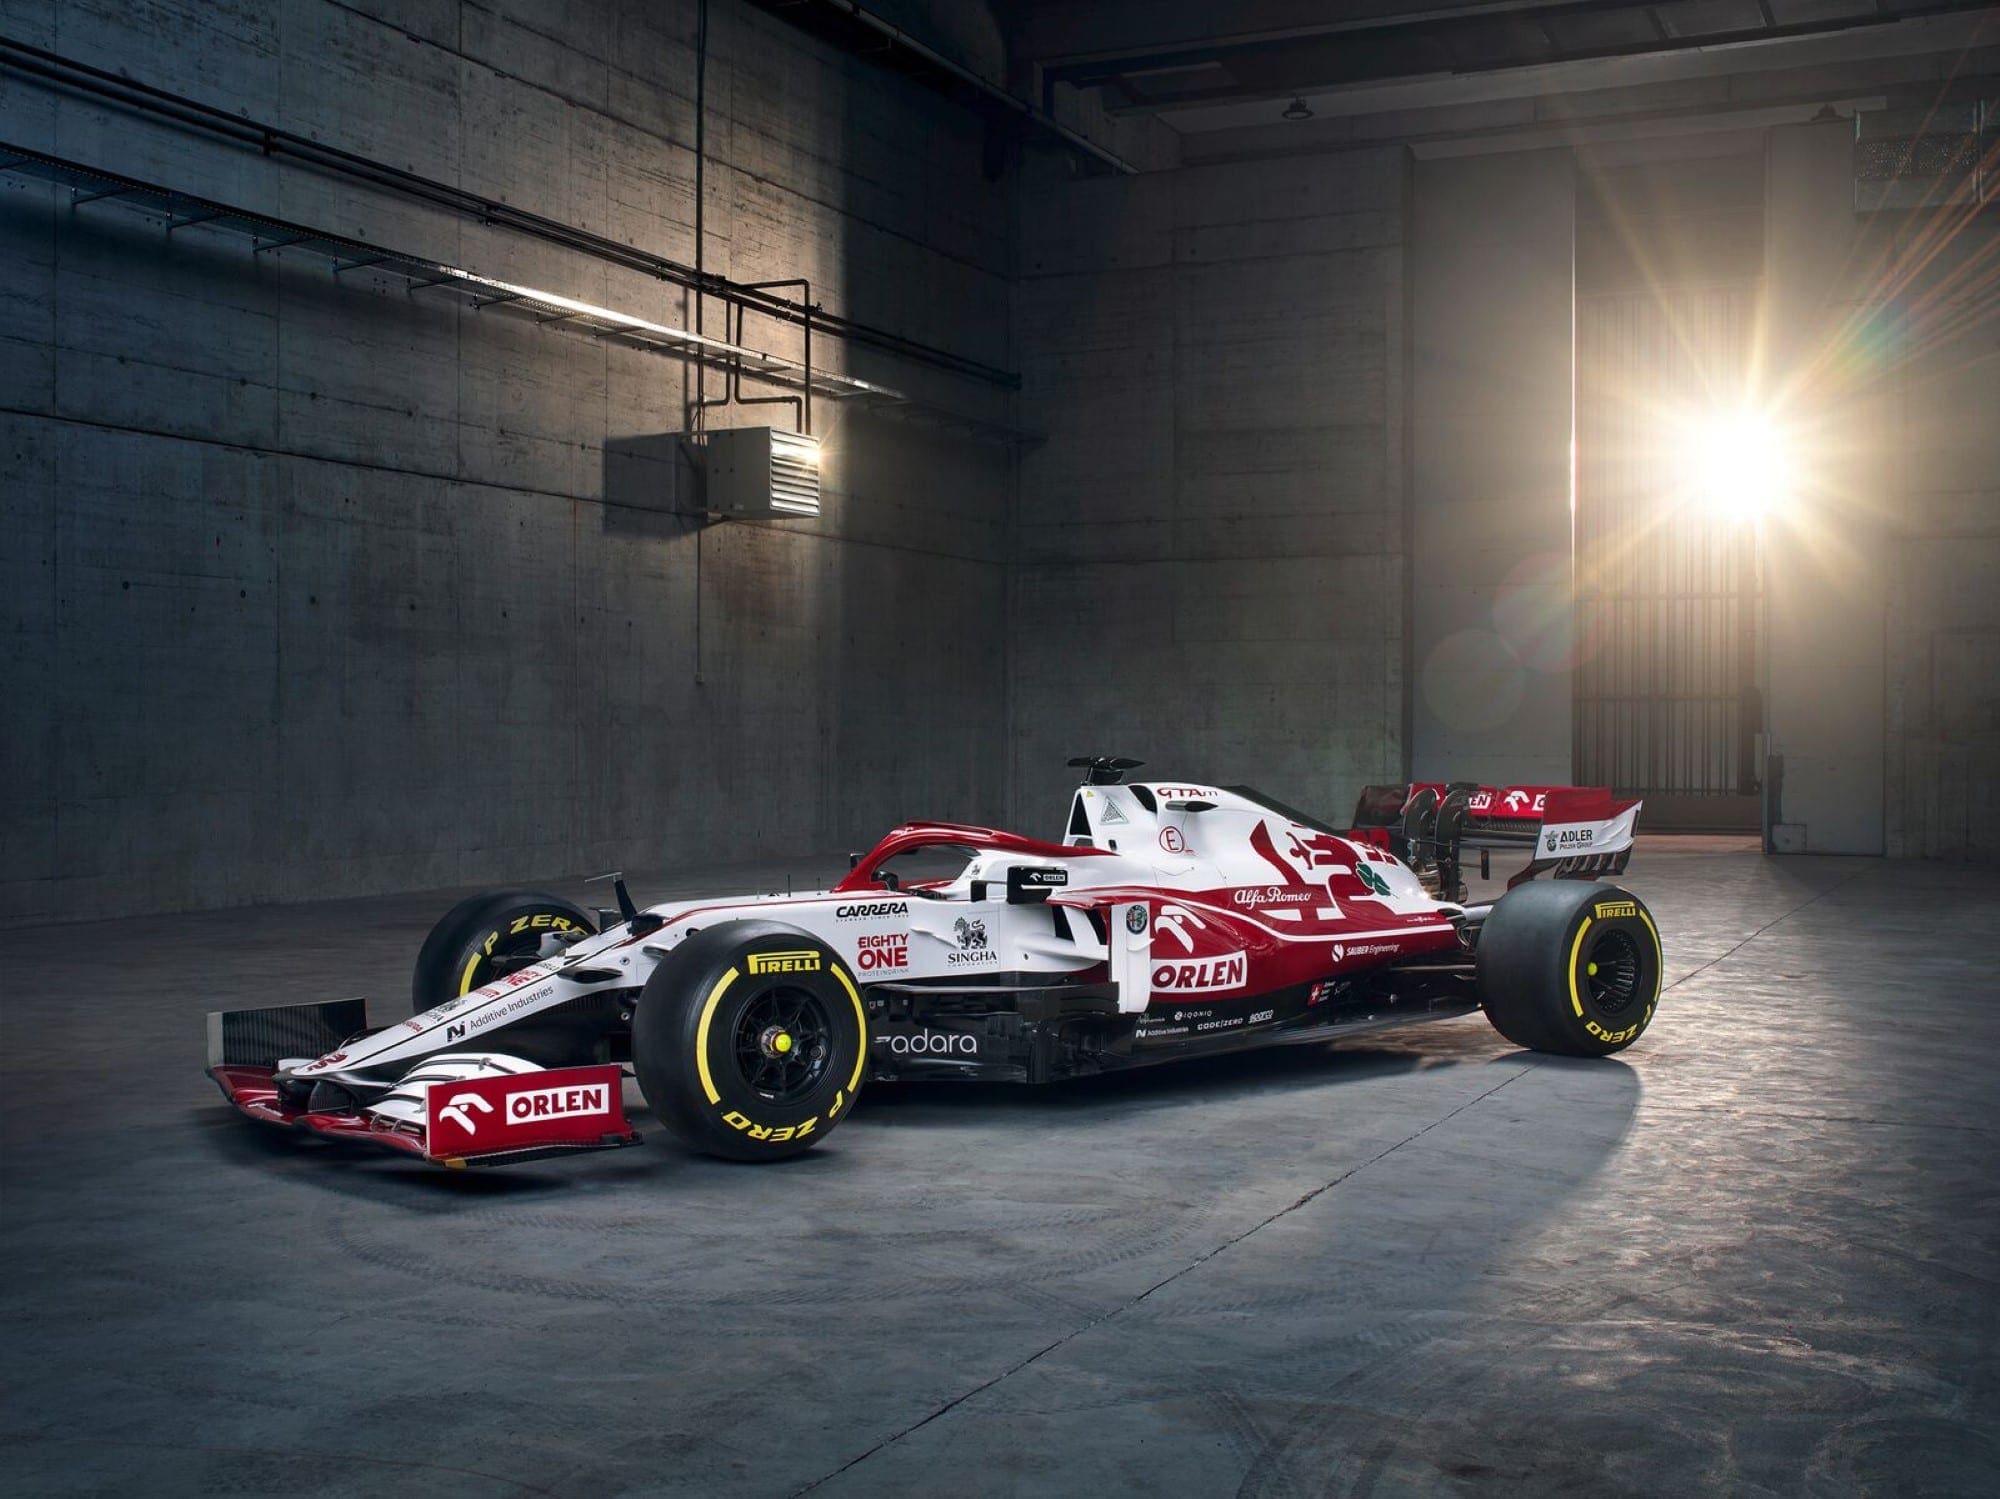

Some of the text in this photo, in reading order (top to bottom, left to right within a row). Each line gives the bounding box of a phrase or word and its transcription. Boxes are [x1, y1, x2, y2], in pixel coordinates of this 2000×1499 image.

[1165, 830, 1179, 851] E
[1560, 829, 1593, 842] ADLER
[836, 902, 909, 918] CARRERA
[1234, 886, 1312, 910] Alfa Romeo
[1594, 901, 1637, 919] PIRELLI
[484, 931, 498, 956] P
[857, 933, 909, 949] EIGHTY
[747, 950, 821, 975] PIRELLI
[858, 946, 908, 970] ONE
[948, 951, 997, 963] SINGHA
[1152, 957, 1243, 989] ORLEN
[470, 1007, 508, 1030] Additive
[508, 984, 554, 1012] Industries
[1584, 1020, 1638, 1043] ZERO
[511, 1088, 603, 1118] ORLEN
[722, 1090, 843, 1142] P ZERO
